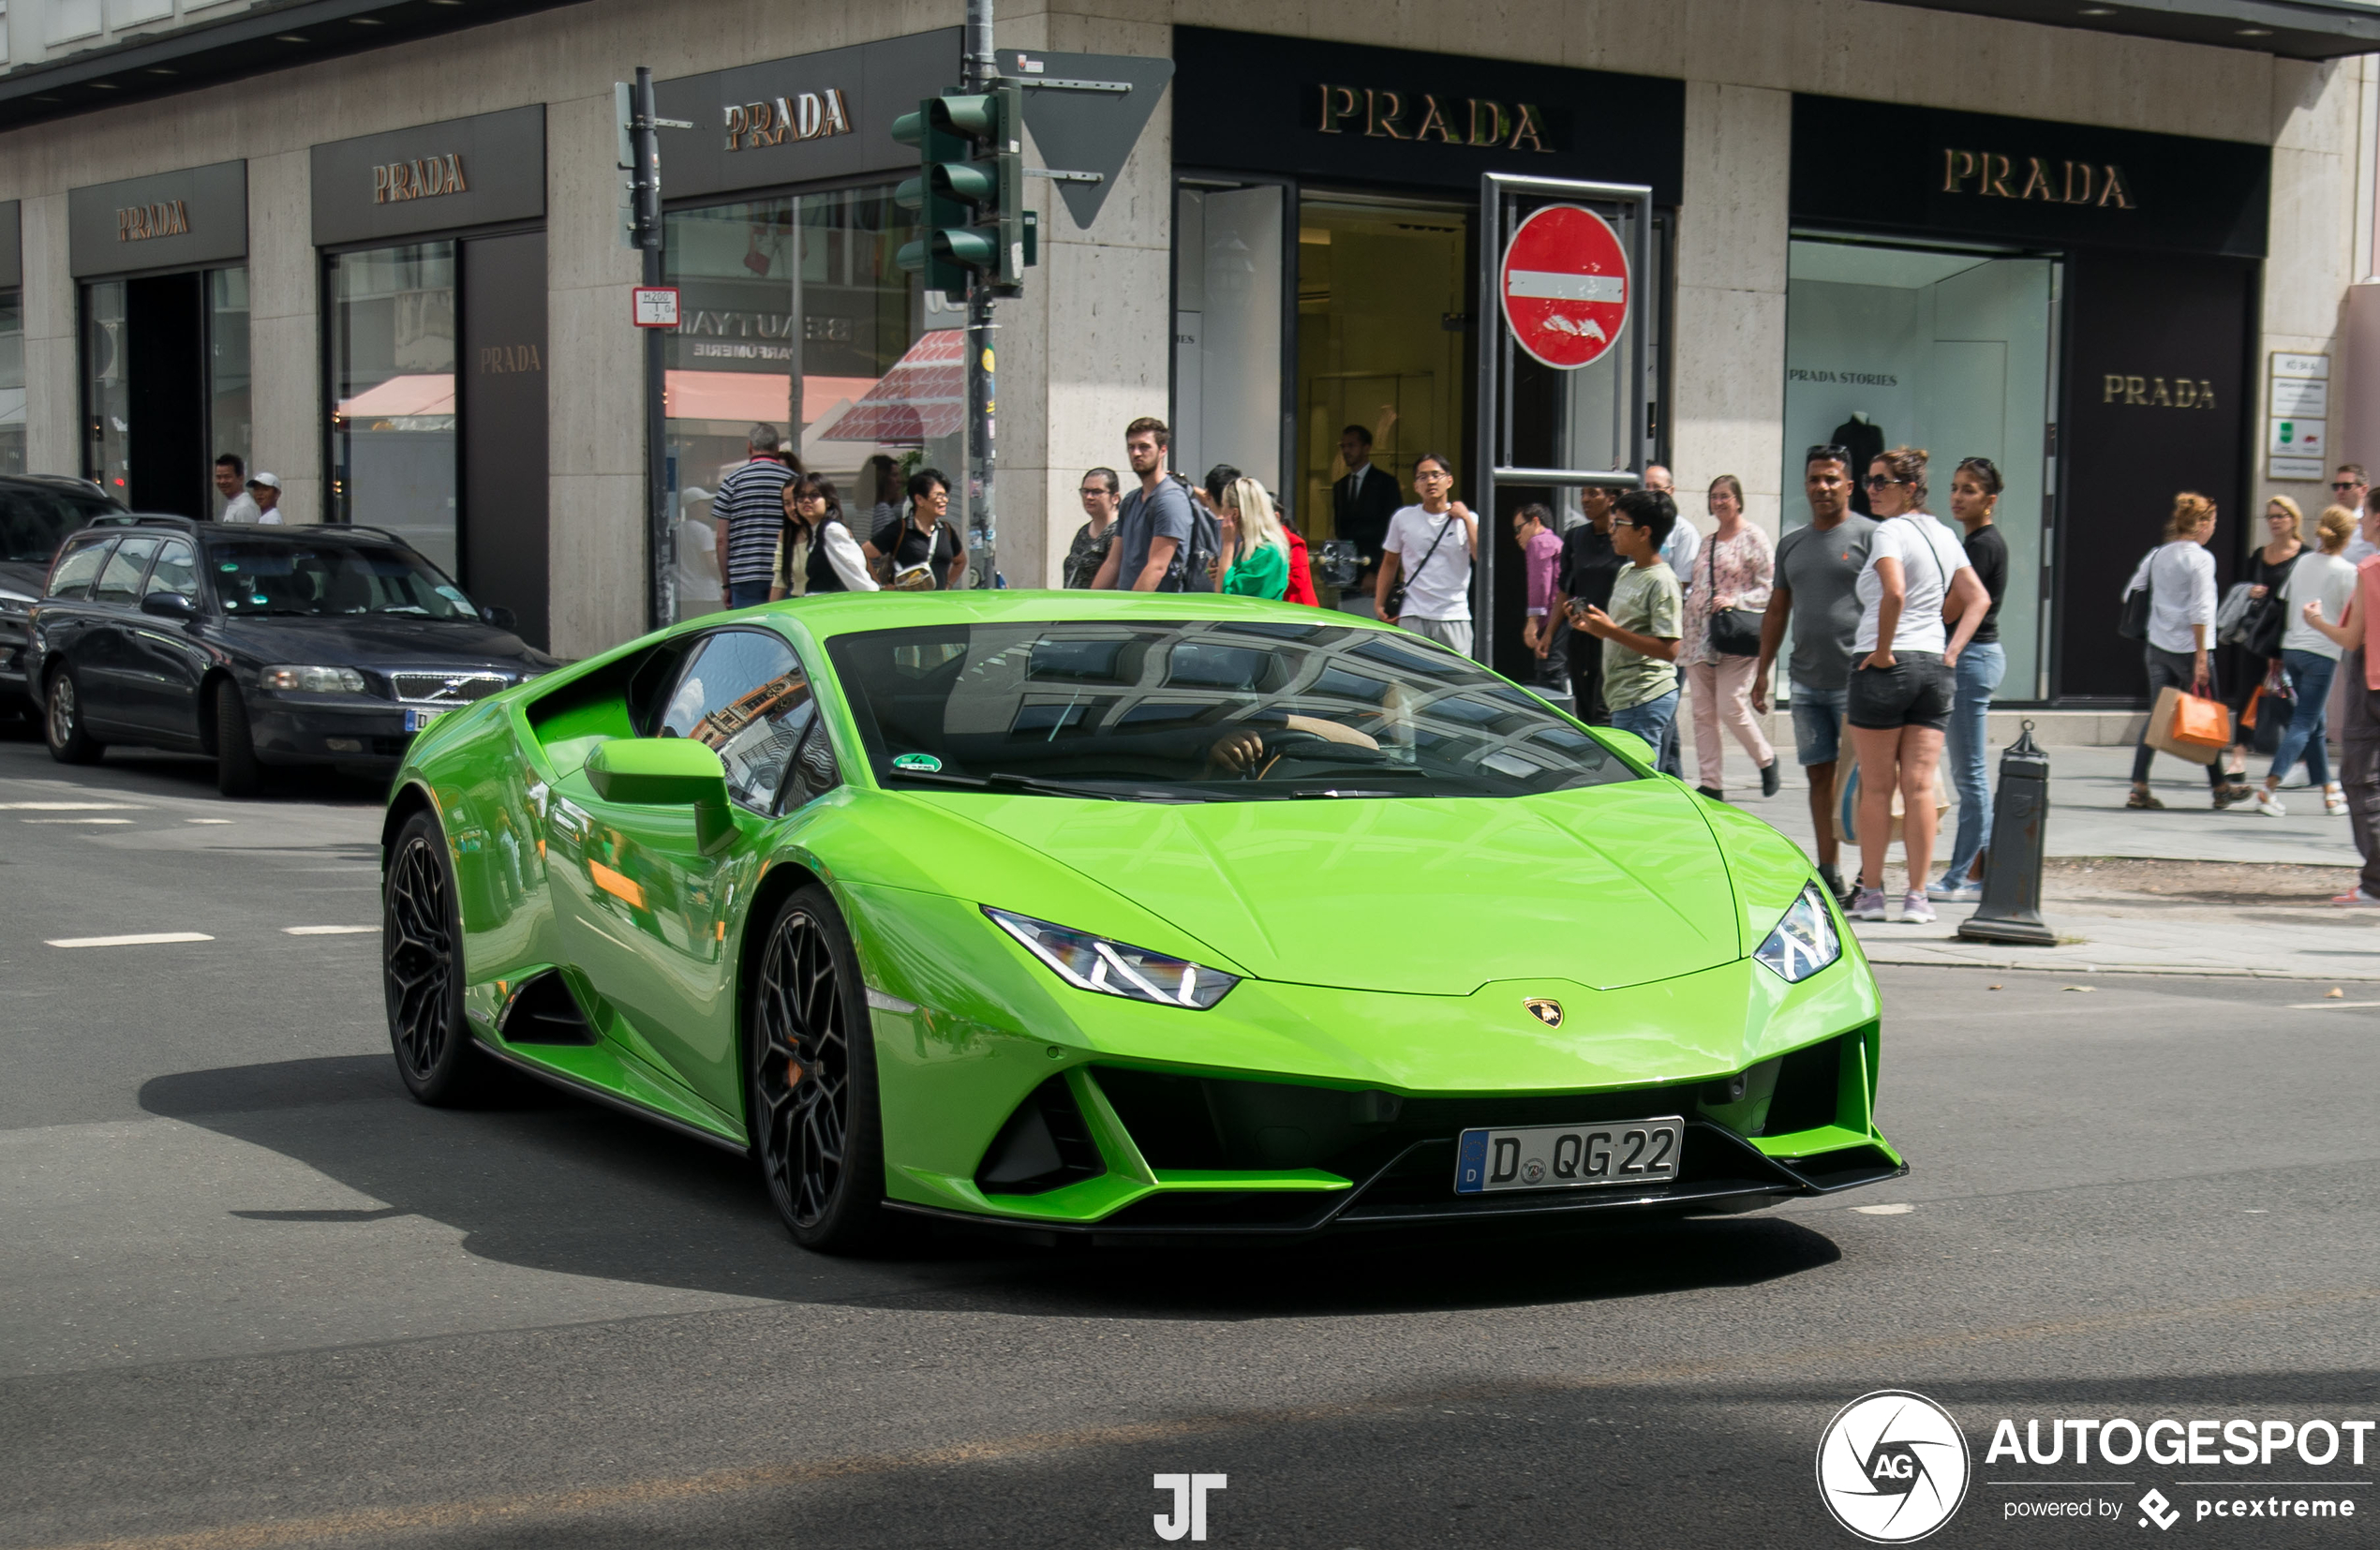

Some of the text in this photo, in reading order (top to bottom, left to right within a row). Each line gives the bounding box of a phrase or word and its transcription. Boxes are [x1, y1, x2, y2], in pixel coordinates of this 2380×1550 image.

[723, 88, 852, 151] PRADA
[1318, 84, 1556, 153] PRADA
[373, 153, 467, 204] PRADA
[1942, 149, 2137, 209] PRADA
[116, 200, 189, 242] PRADA
[480, 345, 542, 374] PRADA
[1789, 369, 1898, 387] PRADA STORIES
[2103, 375, 2216, 409] PRADA
[1465, 1169, 1477, 1183] D
[1490, 1137, 1522, 1183] D
